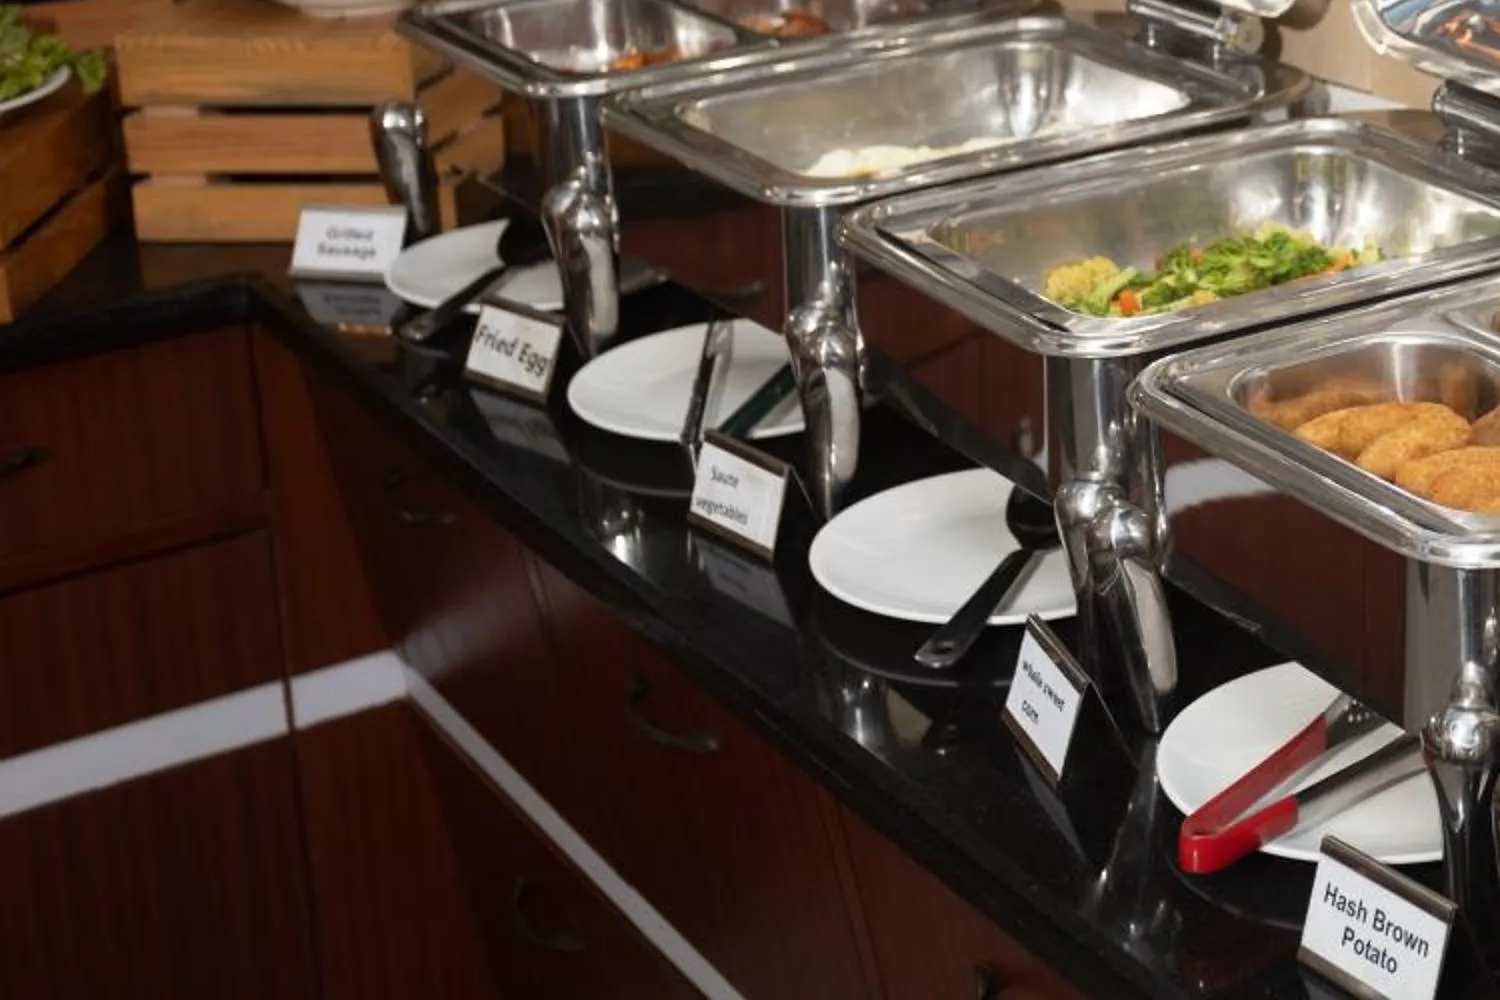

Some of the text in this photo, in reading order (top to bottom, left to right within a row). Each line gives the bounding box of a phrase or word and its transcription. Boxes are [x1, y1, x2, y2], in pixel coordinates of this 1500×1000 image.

[317, 242, 378, 261] Sausage
[476, 323, 549, 378] Fried Egg
[1323, 881, 1430, 959] Hash Brown
[1341, 926, 1398, 975] Potato
